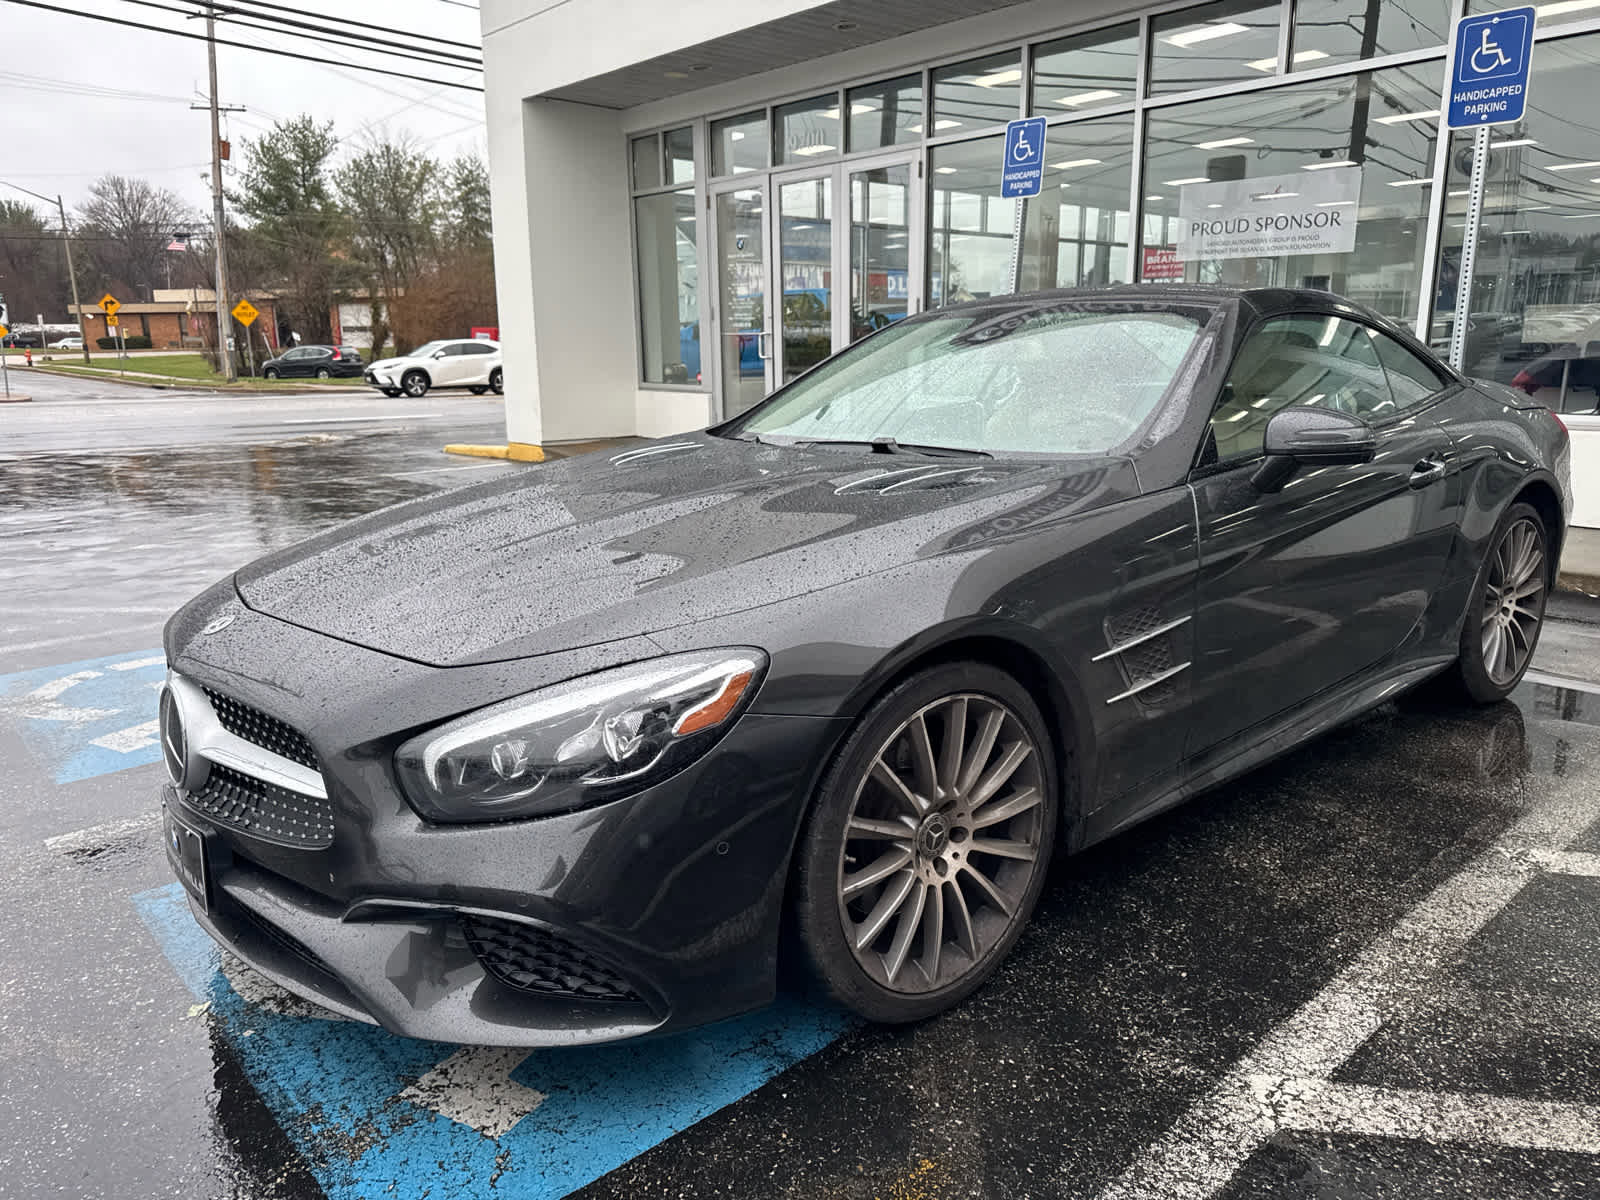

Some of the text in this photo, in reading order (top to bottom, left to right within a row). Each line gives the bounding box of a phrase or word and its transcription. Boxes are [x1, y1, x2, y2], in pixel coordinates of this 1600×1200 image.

[1453, 84, 1522, 103] HANDICAPPED
[1464, 100, 1508, 116] PARKING
[1004, 169, 1041, 181] HANDICAPPED
[1010, 181, 1033, 190] PARKING
[1191, 211, 1342, 237] PROUD SPONSOR
[1298, 233, 1321, 242] PROUD
